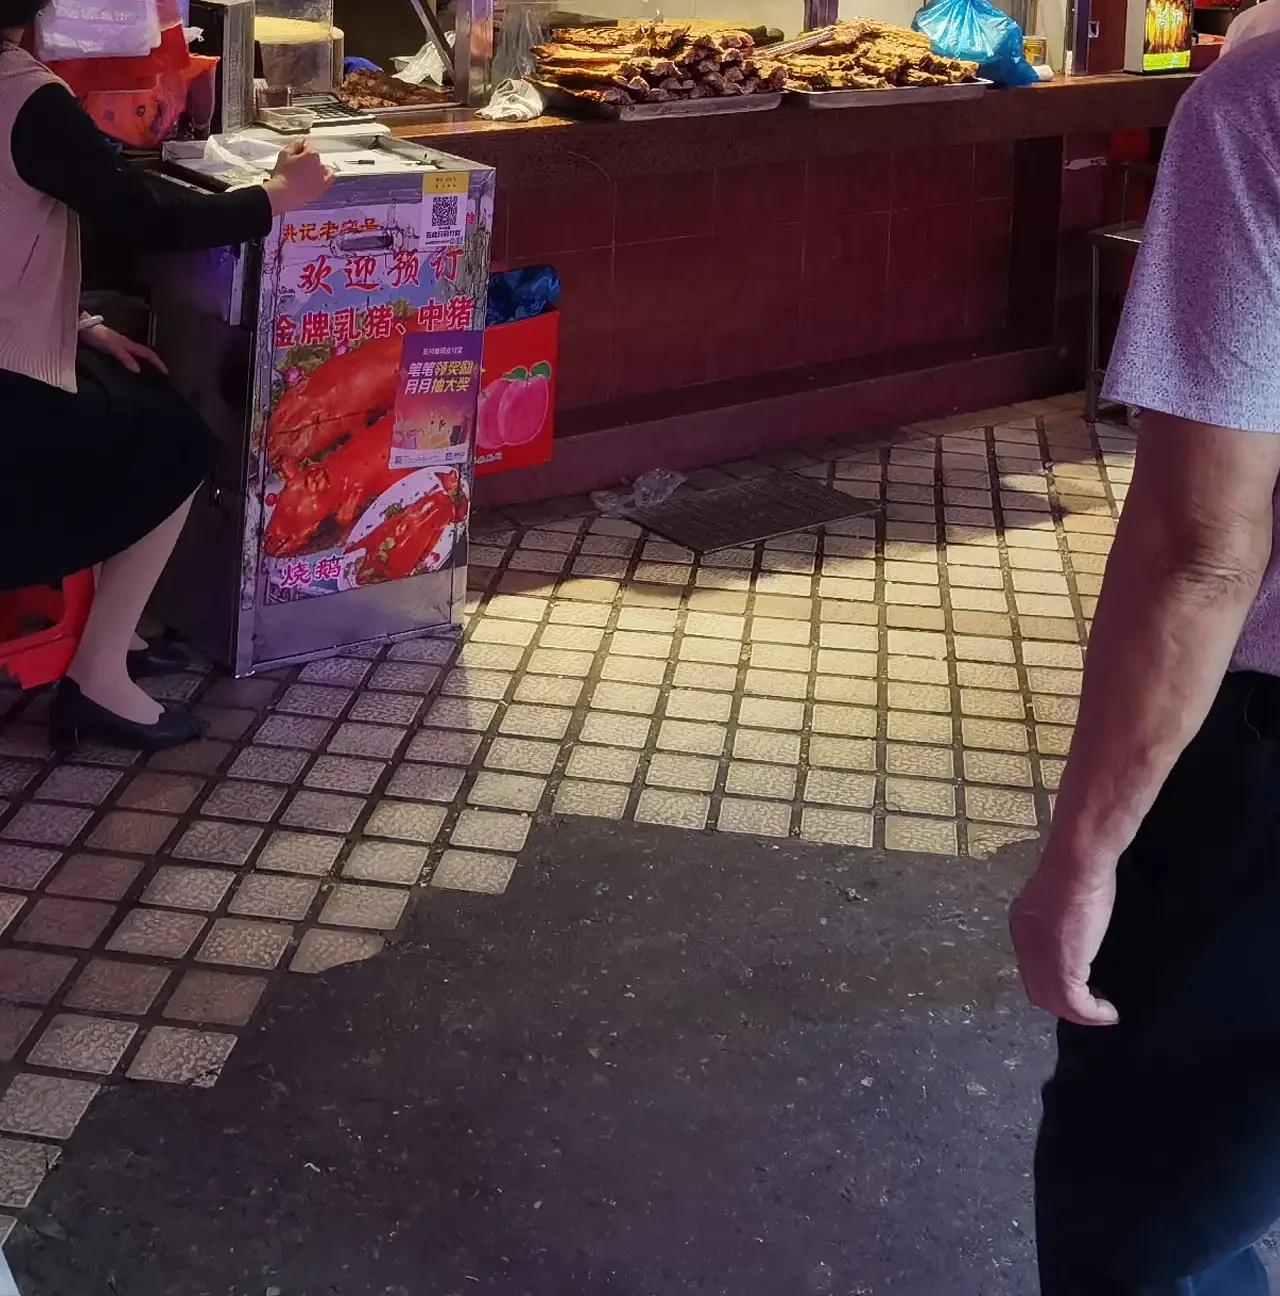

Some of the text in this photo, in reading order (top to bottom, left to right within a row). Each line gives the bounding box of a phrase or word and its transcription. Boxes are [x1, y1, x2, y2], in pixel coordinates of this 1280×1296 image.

[296, 247, 465, 296] 欢迎预订
[274, 294, 476, 350] 金牌乳猪、中猪
[404, 376, 472, 396] 月月抽大奖
[279, 554, 343, 590] 烧鹅
